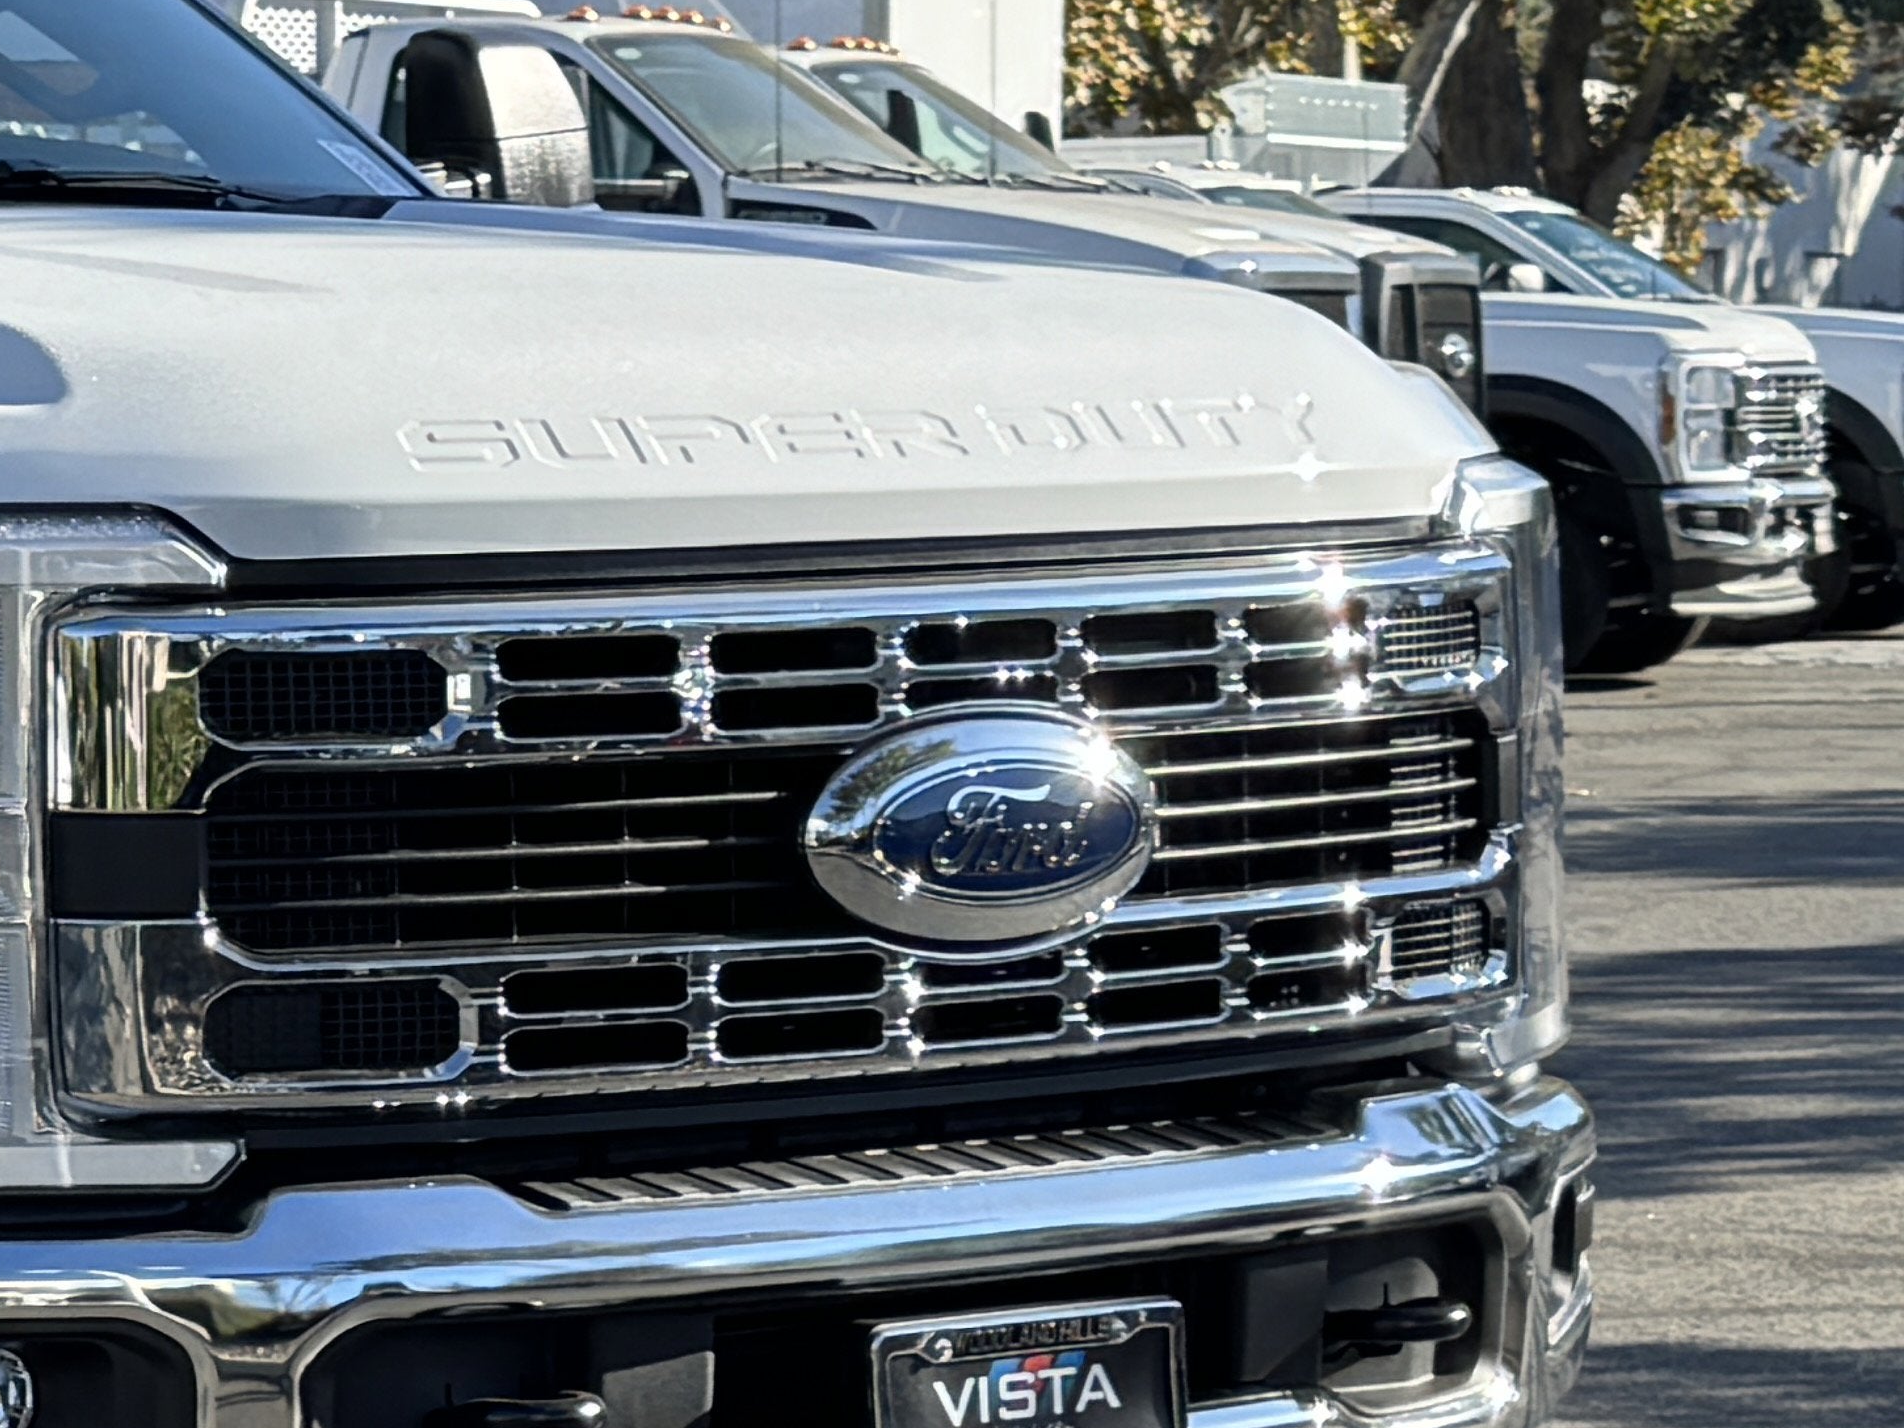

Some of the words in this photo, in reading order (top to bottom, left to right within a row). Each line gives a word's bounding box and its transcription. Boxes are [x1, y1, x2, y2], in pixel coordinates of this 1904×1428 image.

[395, 408, 970, 471] SUPER
[974, 392, 1316, 457] DUTY
[930, 782, 1096, 876] Ford
[933, 1363, 1122, 1428] VISTA
